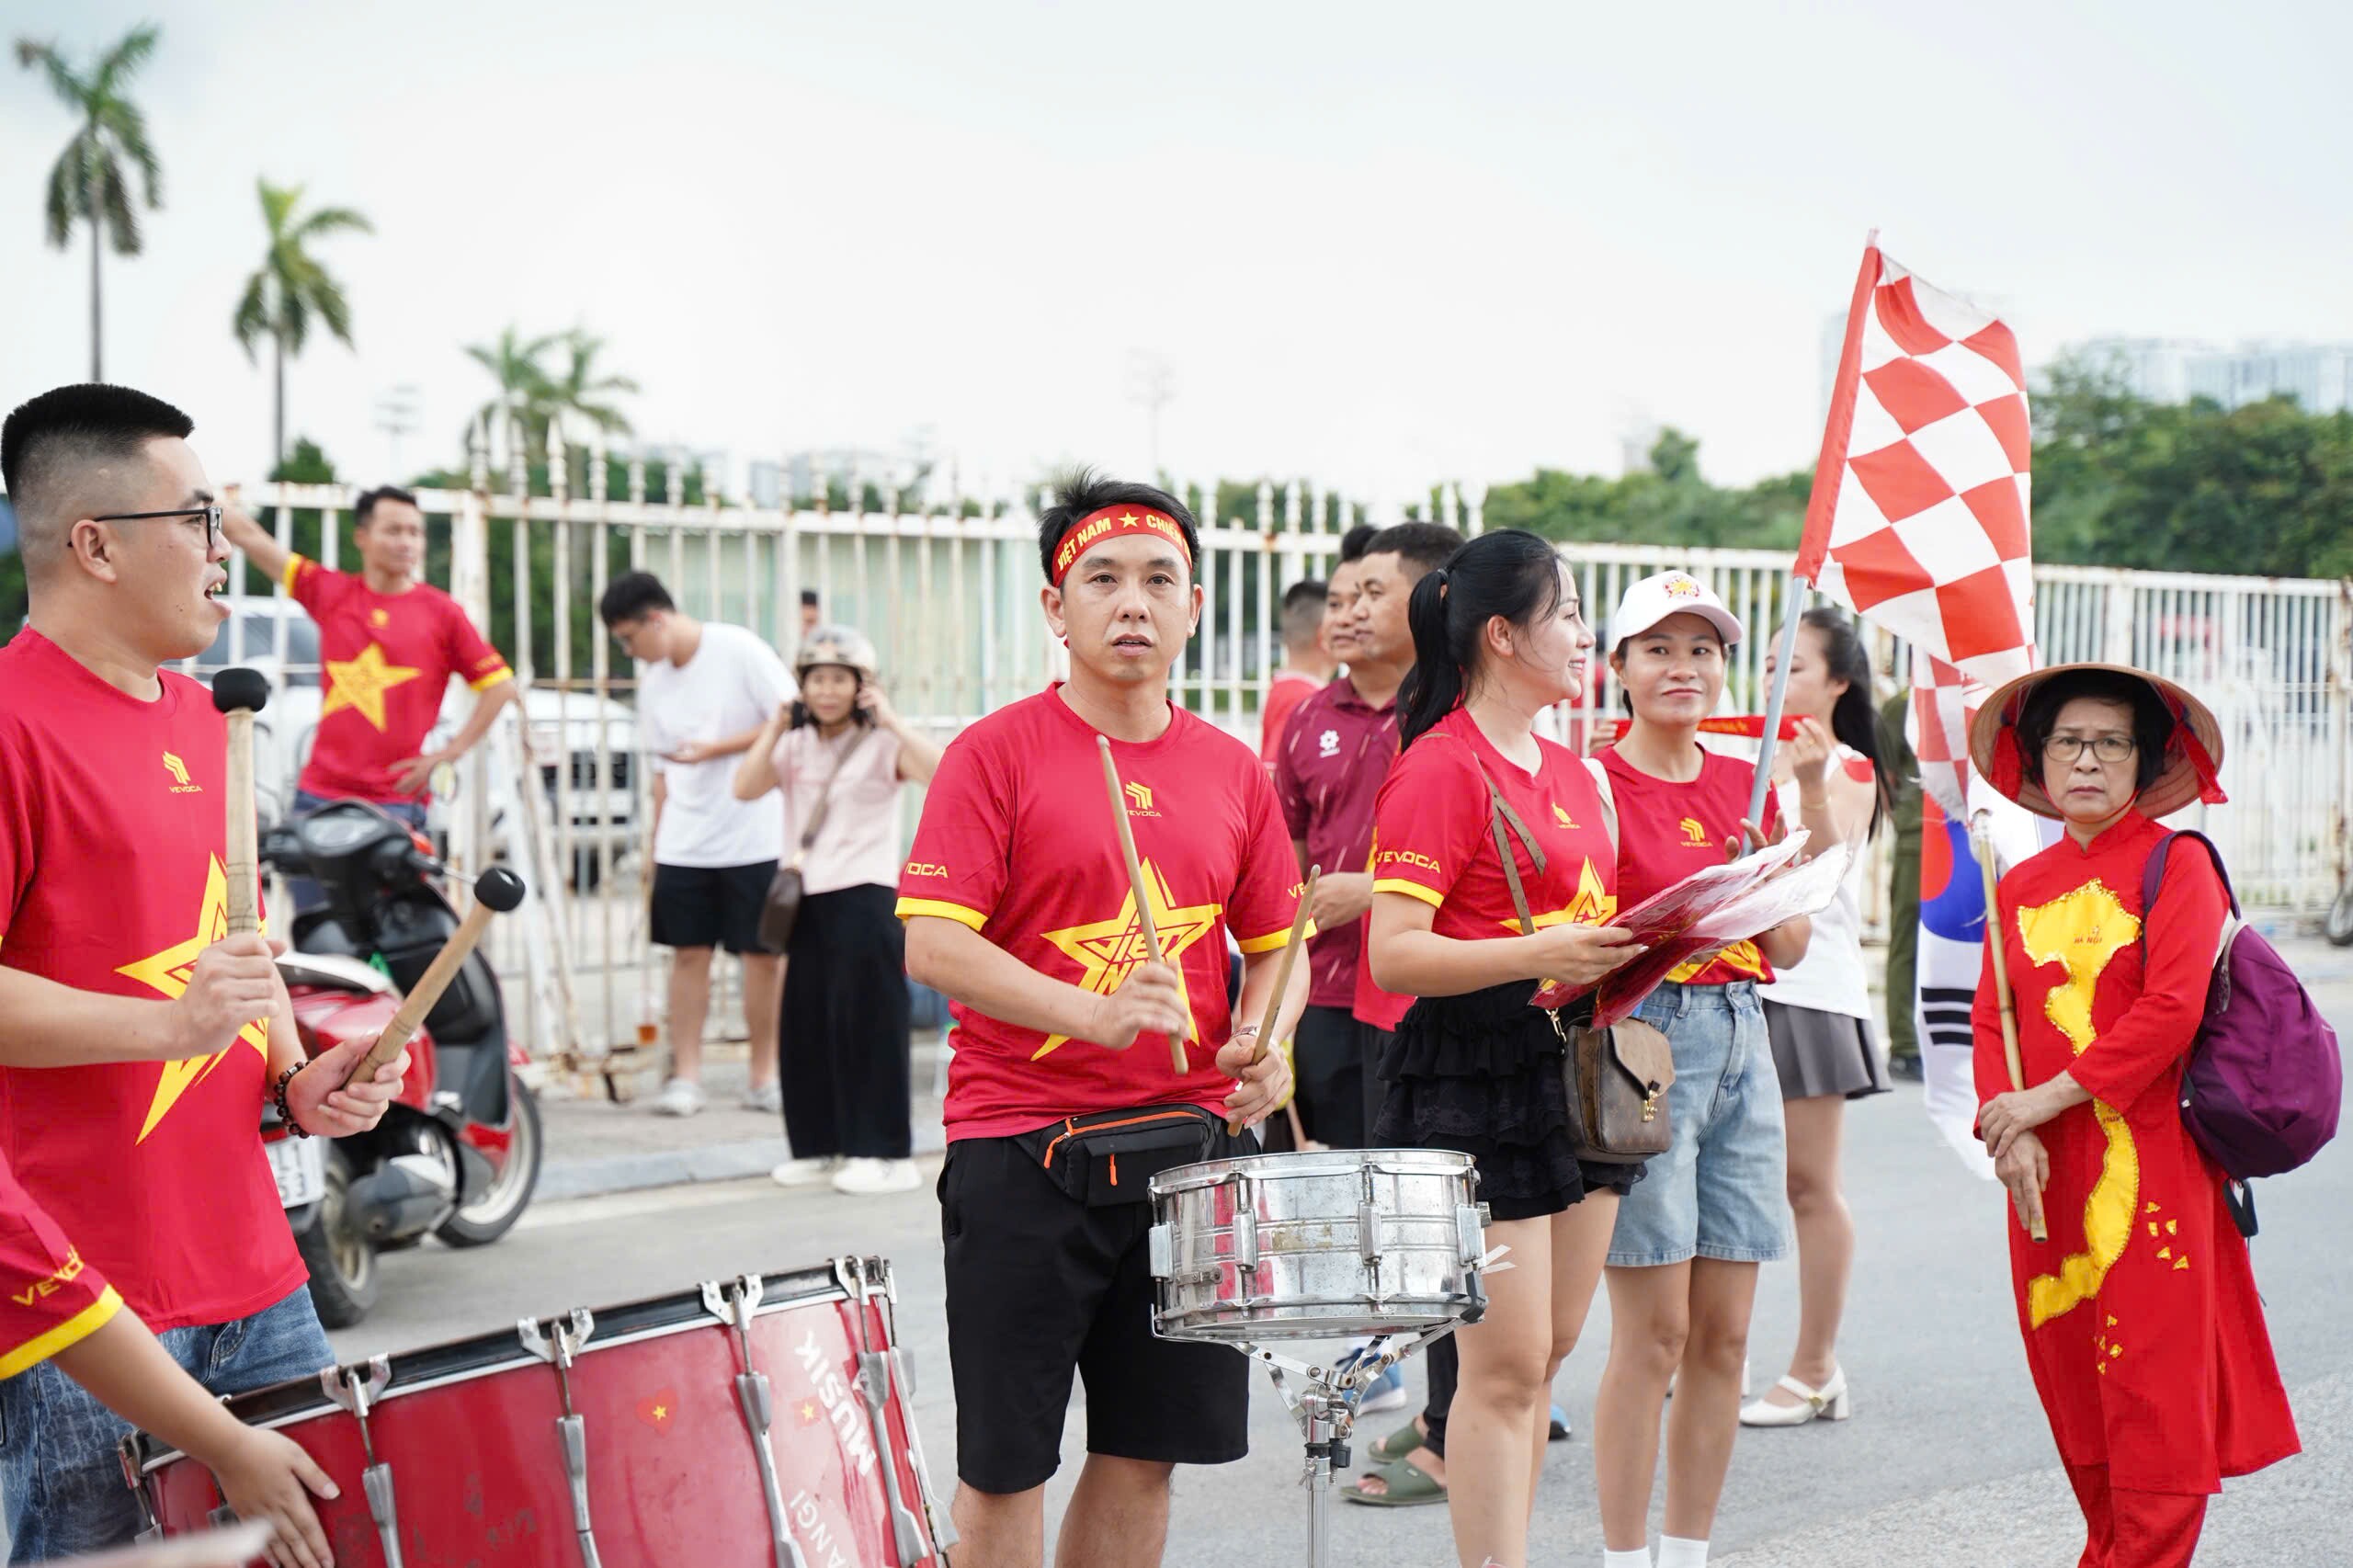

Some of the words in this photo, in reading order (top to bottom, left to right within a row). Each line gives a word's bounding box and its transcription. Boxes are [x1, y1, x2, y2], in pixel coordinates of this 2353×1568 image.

[1057, 540, 1077, 571] VIỆT
[1076, 517, 1112, 548] NAM
[168, 785, 204, 794] VEVOCA
[794, 1329, 877, 1477] MUSIK
